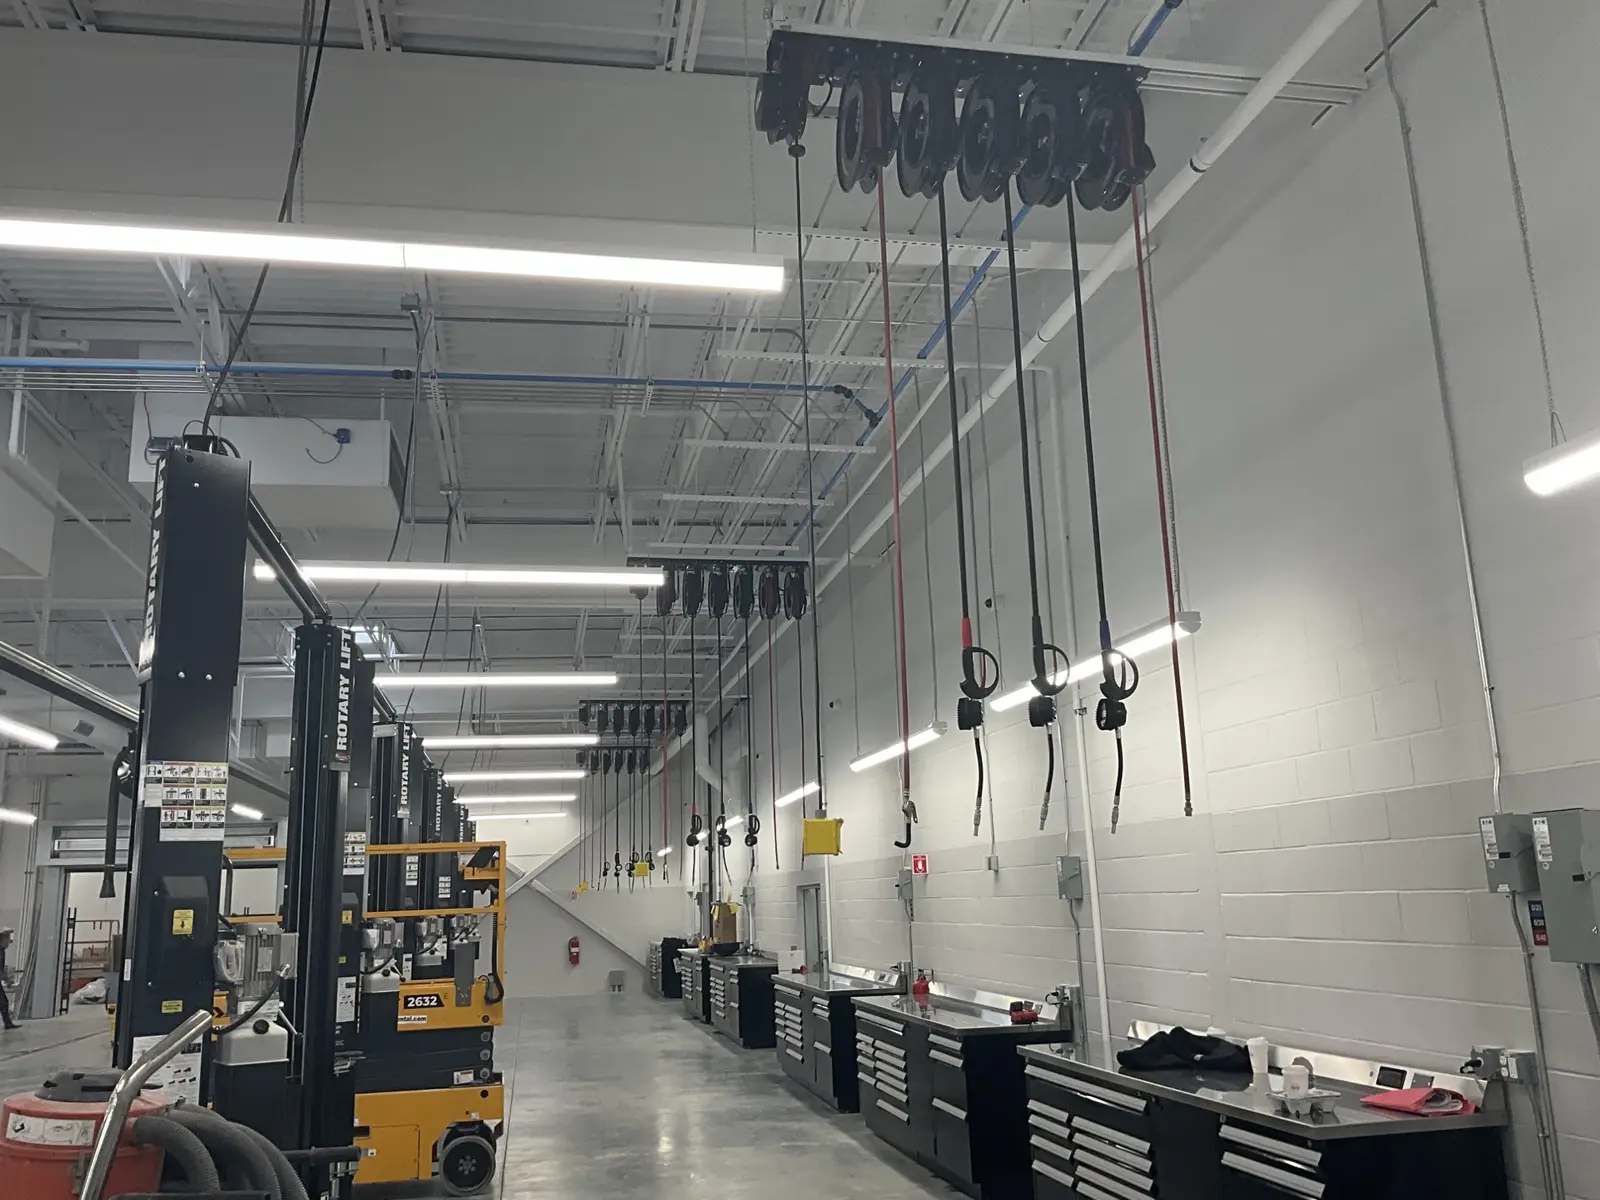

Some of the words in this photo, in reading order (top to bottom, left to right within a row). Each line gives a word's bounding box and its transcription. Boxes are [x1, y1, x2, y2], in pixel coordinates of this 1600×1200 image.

[154, 458, 167, 519] LIFT
[340, 629, 352, 670] LIFT
[336, 673, 350, 751] ROTARY
[402, 722, 411, 751] LIFT
[400, 753, 410, 805] ROTARY
[407, 996, 438, 1007] 2632
